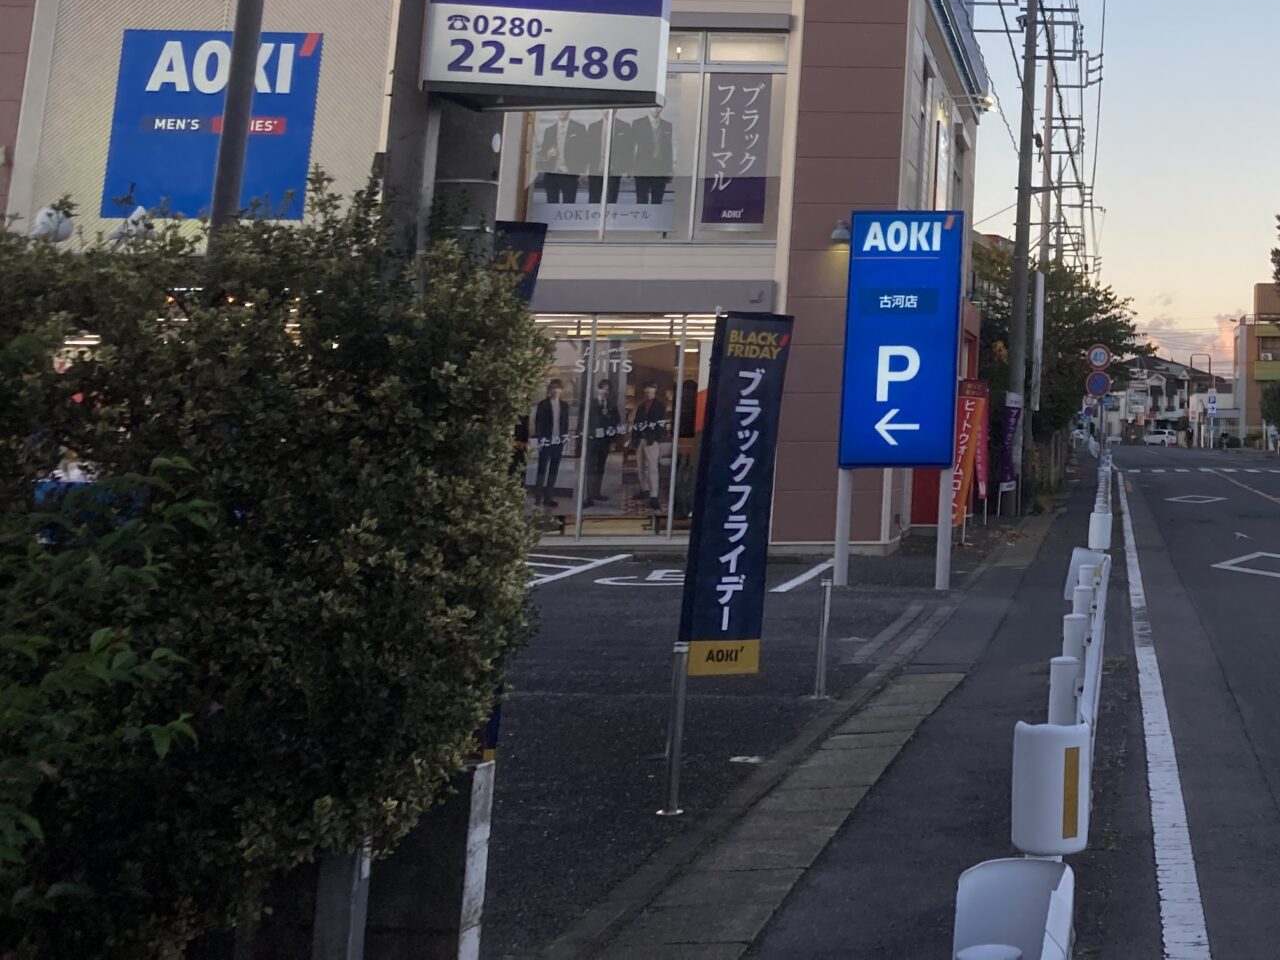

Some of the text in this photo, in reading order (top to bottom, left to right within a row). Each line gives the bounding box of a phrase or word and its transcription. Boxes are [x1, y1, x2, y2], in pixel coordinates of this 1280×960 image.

[447, 39, 639, 82] 22-1486
[154, 118, 200, 130] MEN'S
[711, 84, 736, 192] フォーマル
[738, 83, 766, 176] ブラック
[879, 295, 918, 308] 古河店
[727, 343, 782, 359] FRIDAY
[729, 330, 778, 346] BLACK
[876, 345, 921, 402] P
[715, 368, 766, 631] ブラックフライデー
